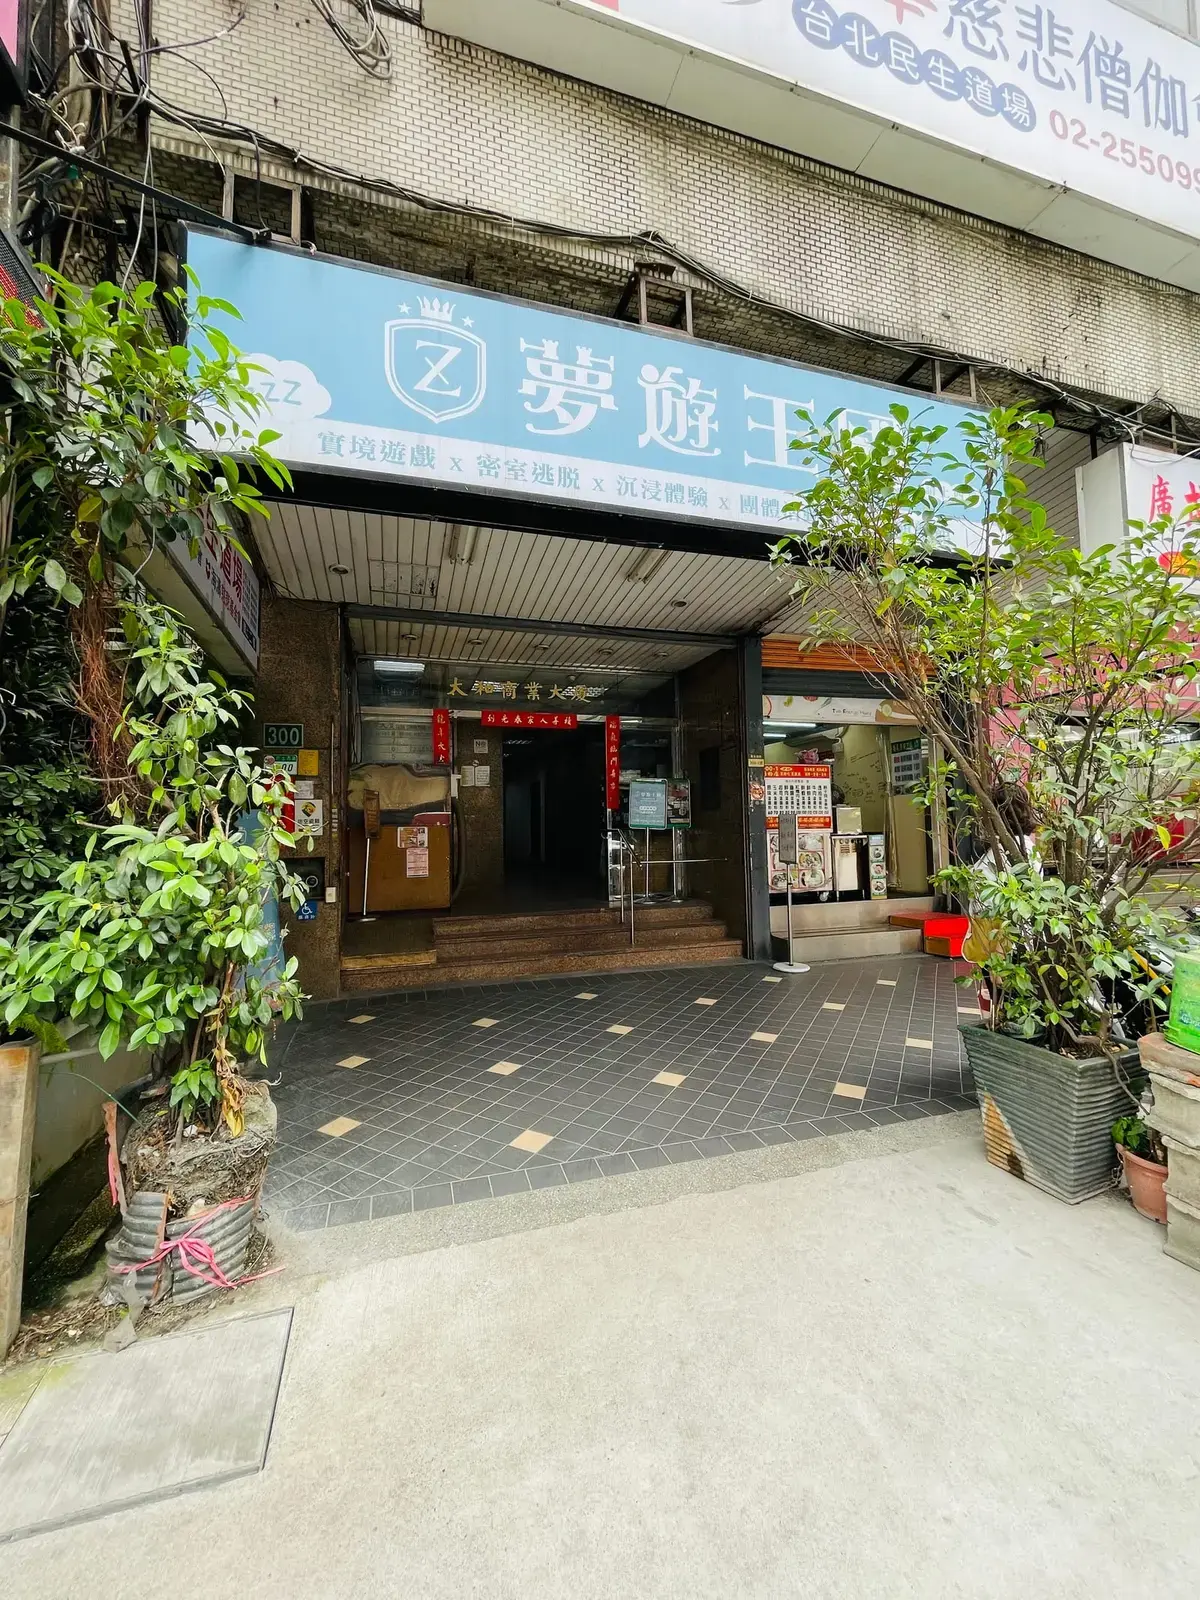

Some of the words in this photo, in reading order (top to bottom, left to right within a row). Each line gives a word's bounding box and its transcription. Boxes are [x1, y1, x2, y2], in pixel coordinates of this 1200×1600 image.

[802, 1, 1032, 128] 台北民生道場
[317, 430, 436, 470] 實境遊戲
[616, 474, 708, 509] 沉浸體驗
[268, 727, 300, 745] 300
